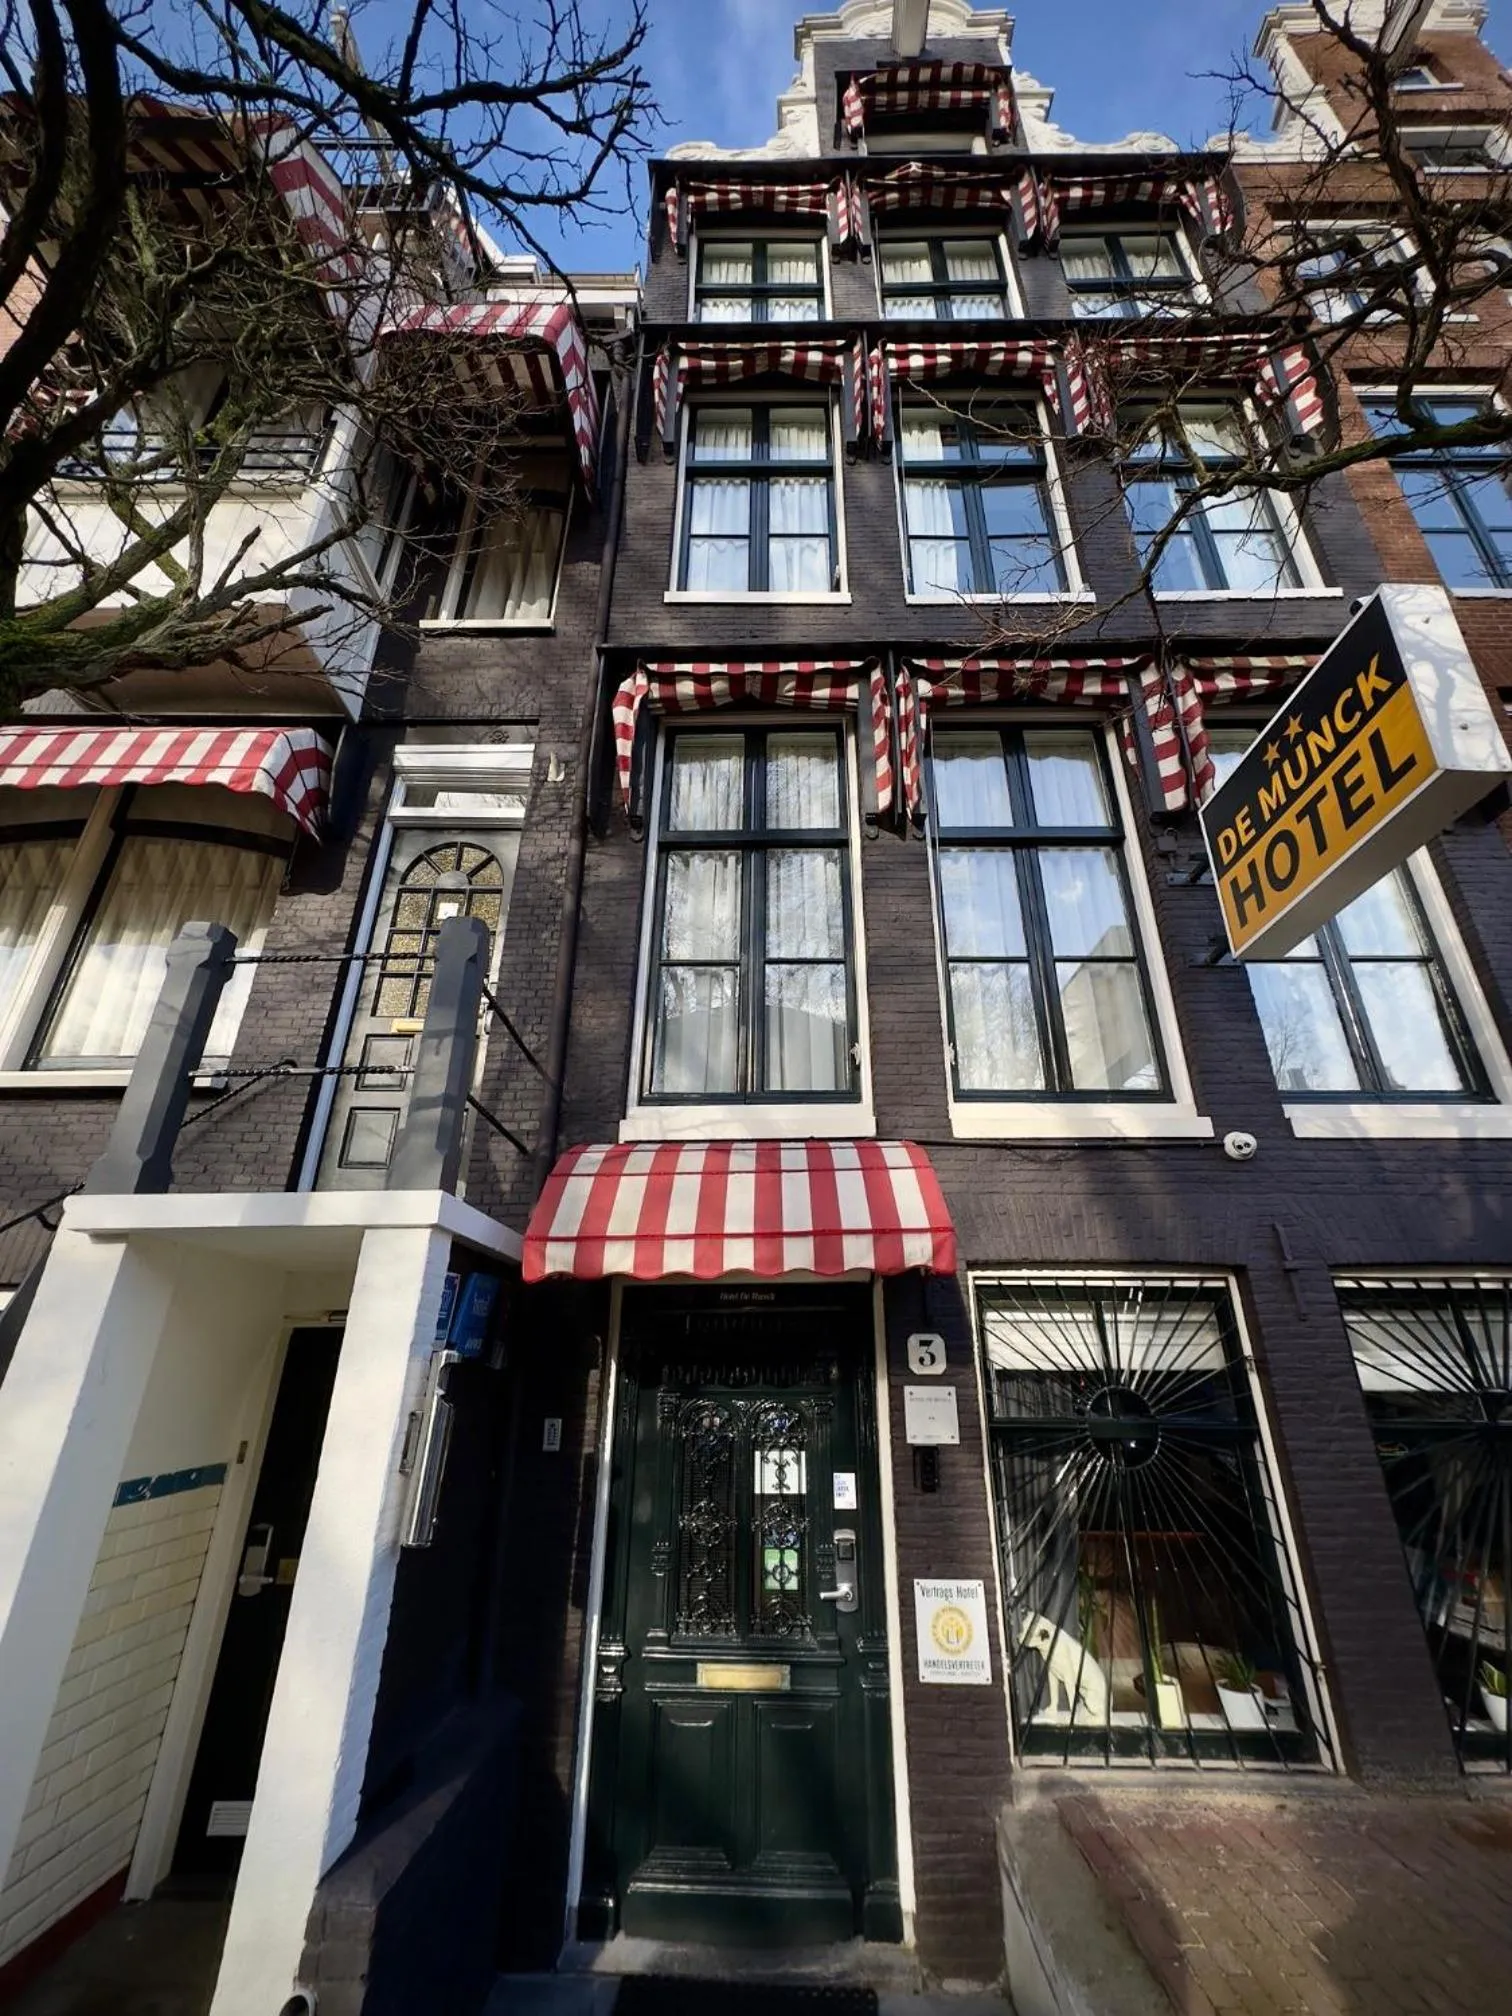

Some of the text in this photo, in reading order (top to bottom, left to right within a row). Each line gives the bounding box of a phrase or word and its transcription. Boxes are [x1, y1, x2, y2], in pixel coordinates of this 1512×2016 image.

[1216, 805, 1256, 866] DE
[1228, 727, 1418, 929] HOTEL
[918, 1339, 937, 1367] 3
[920, 1584, 978, 1601] Vertrags Hotel
